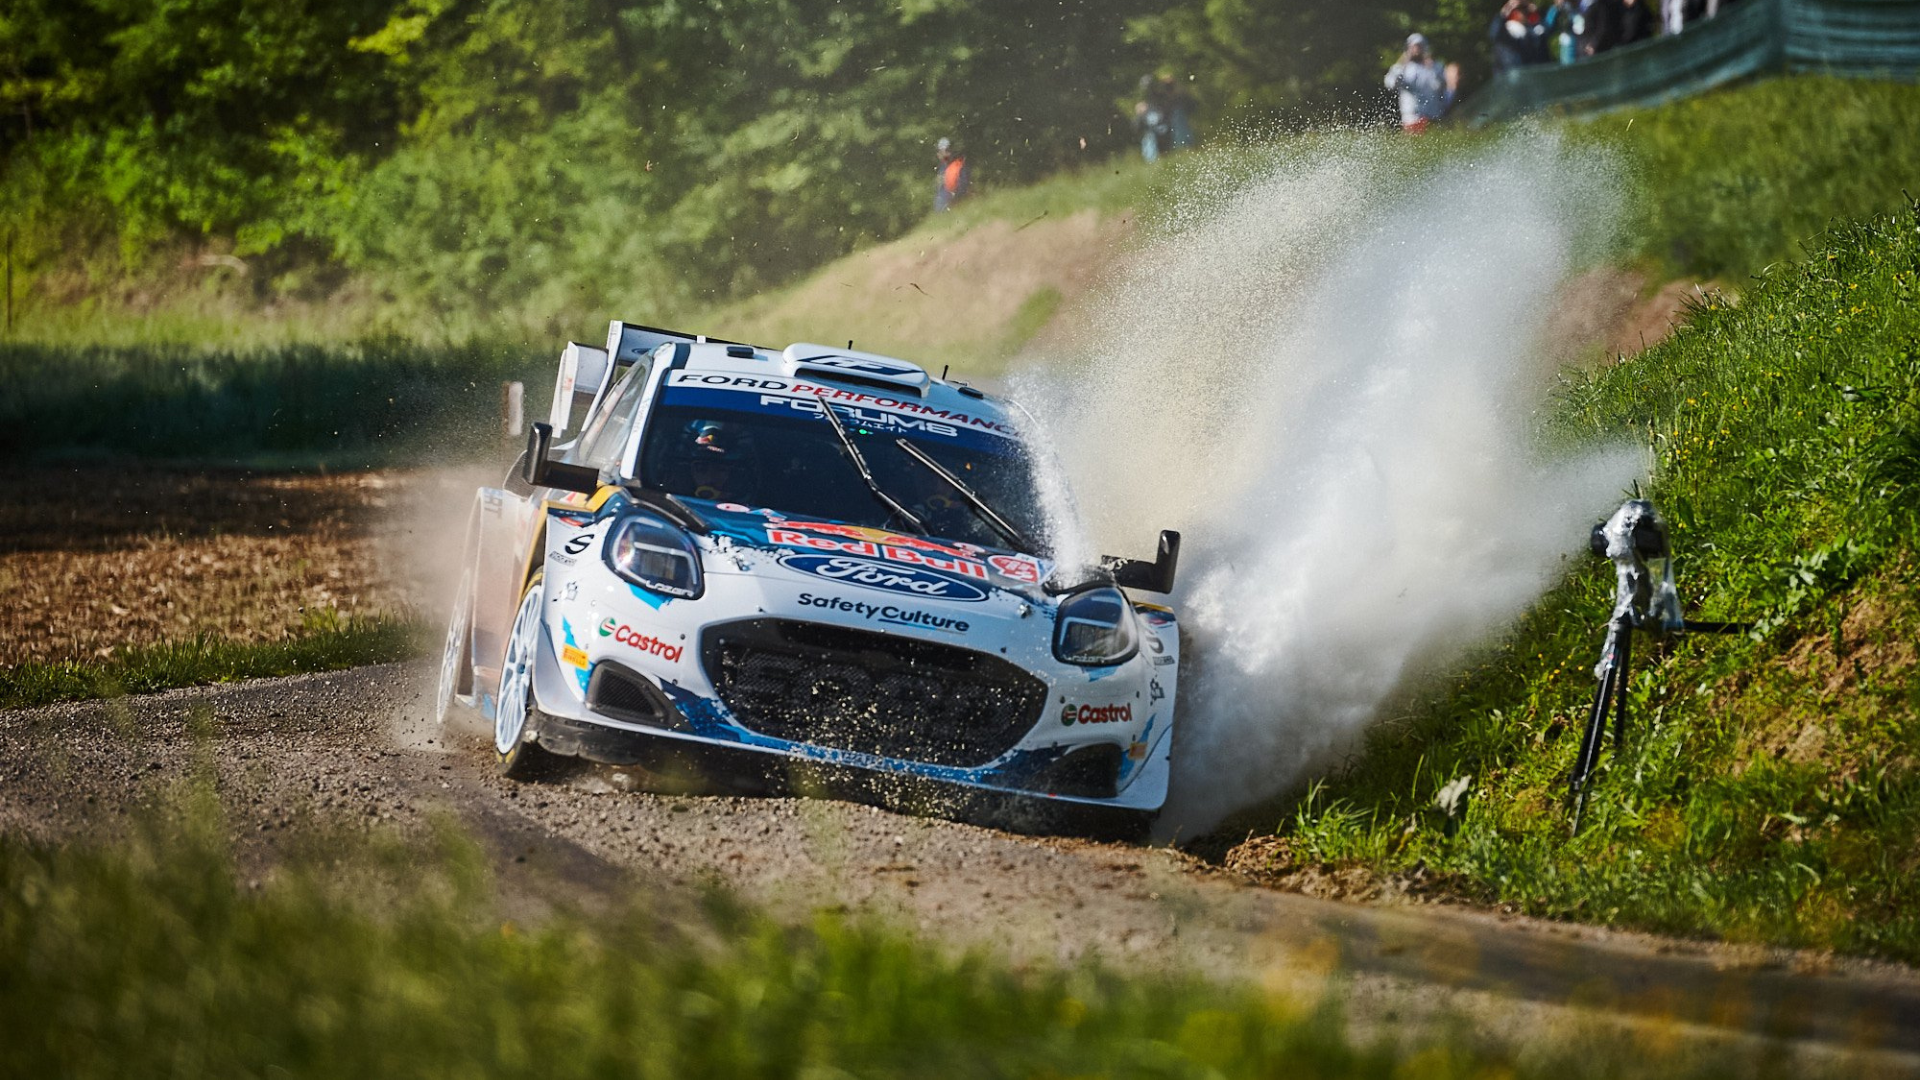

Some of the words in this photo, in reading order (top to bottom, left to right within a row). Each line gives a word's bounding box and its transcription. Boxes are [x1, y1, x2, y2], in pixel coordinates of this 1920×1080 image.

[677, 374, 788, 390] FORD
[791, 384, 1023, 437] PERFORMANC
[760, 395, 958, 437] FORUM8
[813, 413, 908, 434] フーラムエイト
[766, 528, 878, 557] Red
[883, 546, 989, 580] Bull
[814, 557, 951, 596] Ford
[797, 592, 970, 633] SafetyCulture
[614, 624, 684, 664] Castrol
[1078, 702, 1132, 724] Castrol
